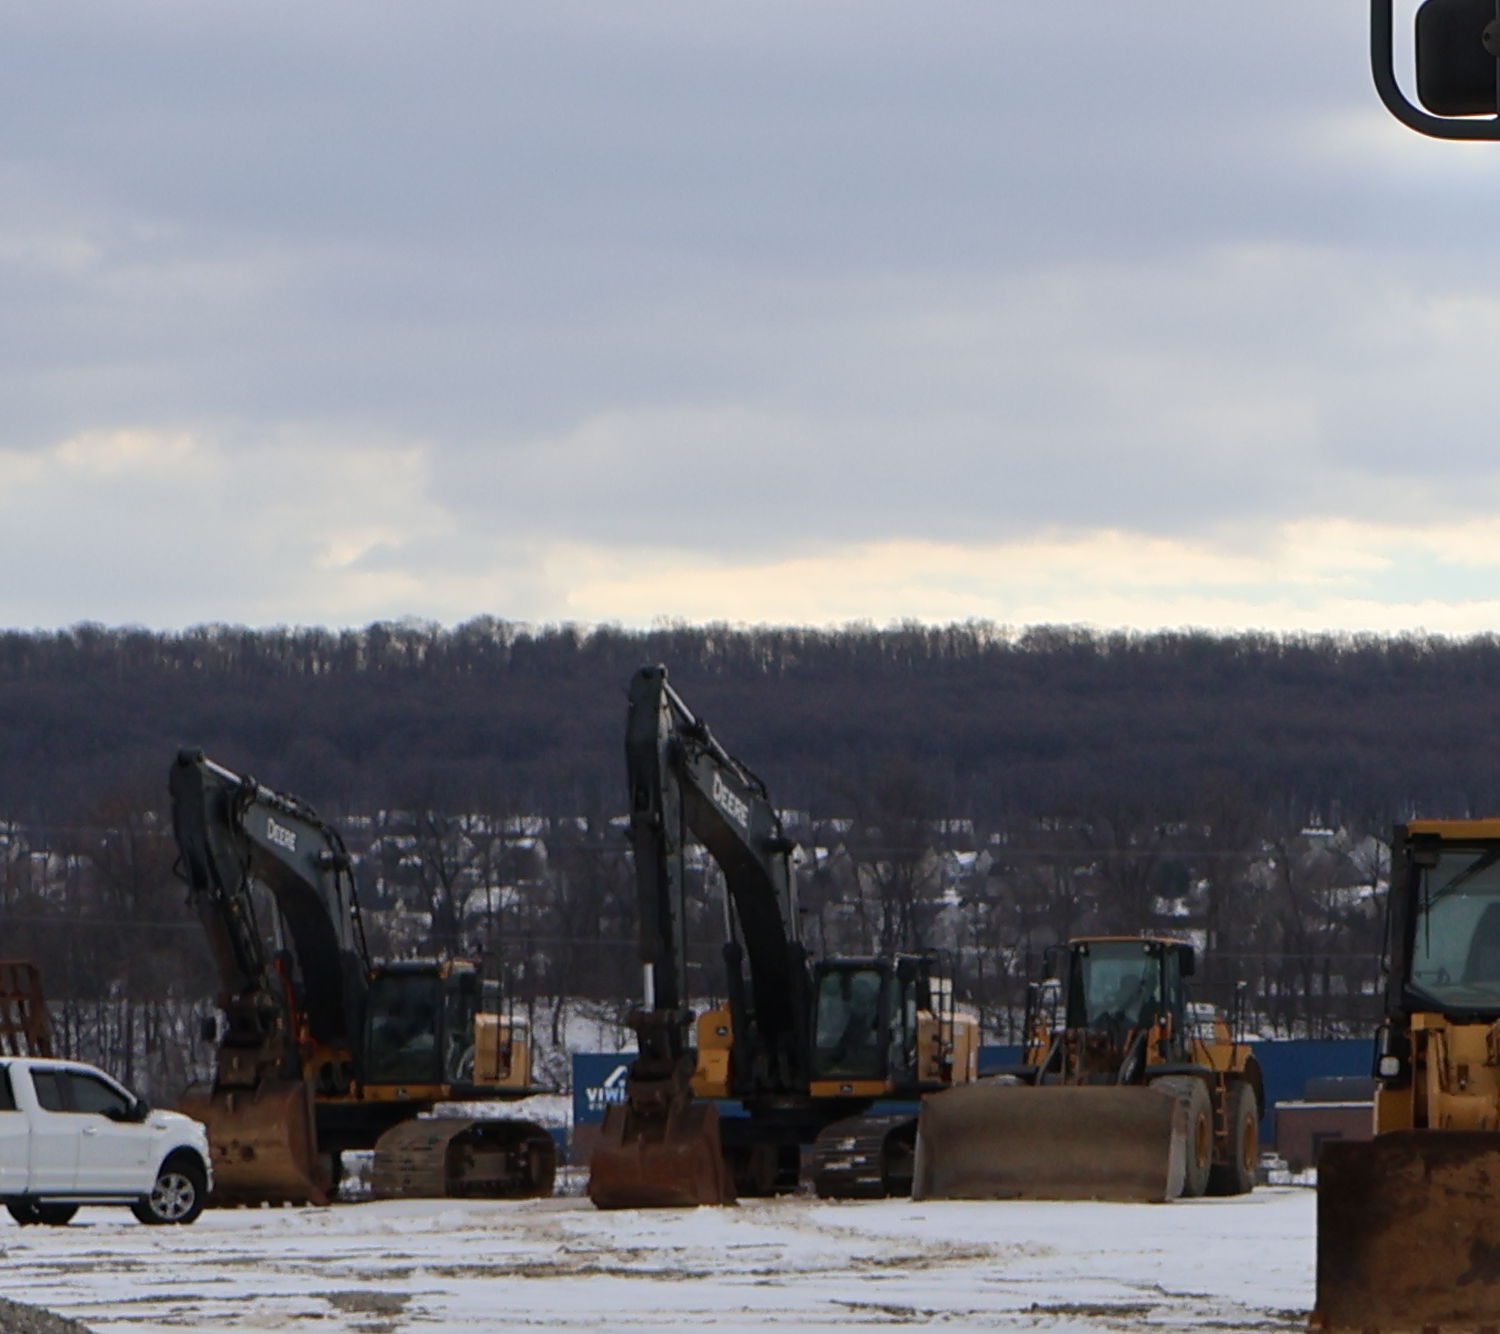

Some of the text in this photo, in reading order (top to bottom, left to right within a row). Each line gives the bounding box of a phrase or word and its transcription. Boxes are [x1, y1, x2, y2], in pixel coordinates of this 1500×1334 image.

[713, 771, 749, 828] DEERE
[267, 817, 296, 852] DEERE
[586, 1087, 627, 1102] VIWI
